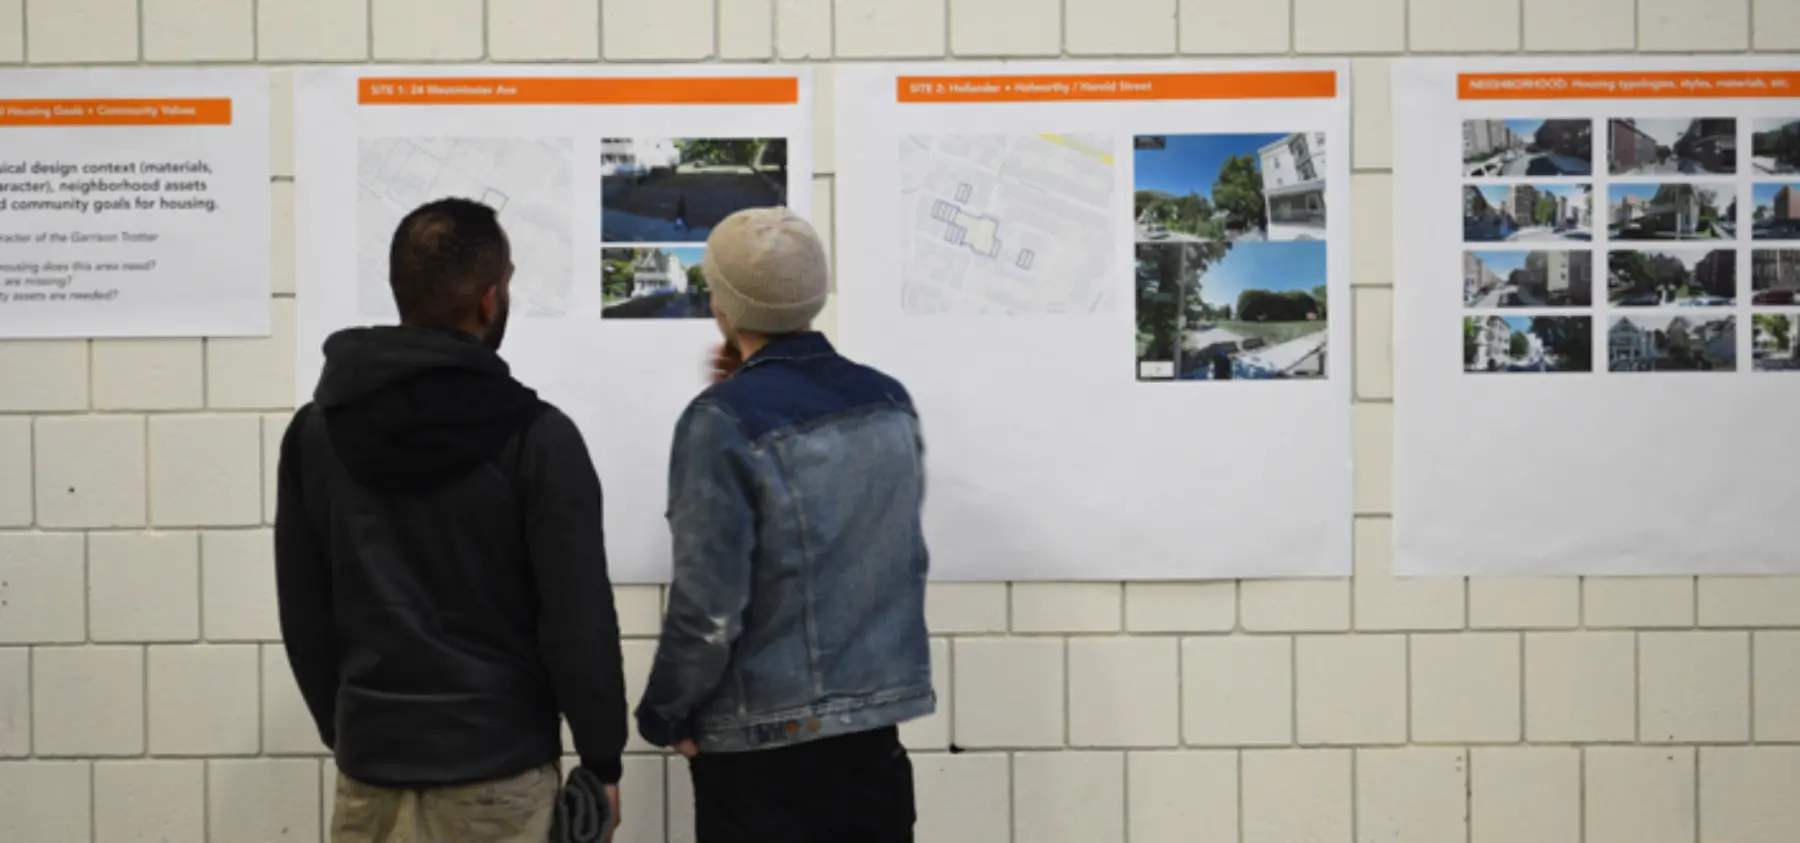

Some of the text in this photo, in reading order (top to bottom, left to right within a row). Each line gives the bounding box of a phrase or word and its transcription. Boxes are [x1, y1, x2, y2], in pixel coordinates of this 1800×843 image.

[427, 84, 493, 95] Westminster
[496, 84, 518, 95] Ave
[909, 83, 934, 94] SITE
[1119, 80, 1152, 92] Street
[1571, 79, 1616, 91] Housing
[7, 105, 51, 119] Housing
[53, 104, 84, 117] Goals
[96, 104, 158, 119] Community
[160, 104, 196, 116] Values
[30, 160, 78, 178] design
[82, 162, 135, 174] context
[140, 160, 213, 175] (materials,
[59, 178, 160, 196] neighborhood
[164, 180, 207, 192] assets
[11, 196, 89, 214] community
[93, 196, 131, 215] goals
[134, 196, 155, 210] for
[34, 231, 47, 243] of
[50, 231, 67, 243] the
[71, 231, 118, 243] Garrison
[121, 231, 159, 243] Trotter
[43, 261, 69, 272] does
[72, 261, 92, 272] this
[94, 263, 119, 272] area
[121, 259, 156, 272] need?
[25, 274, 73, 289] missing?
[69, 288, 119, 301] needed?
